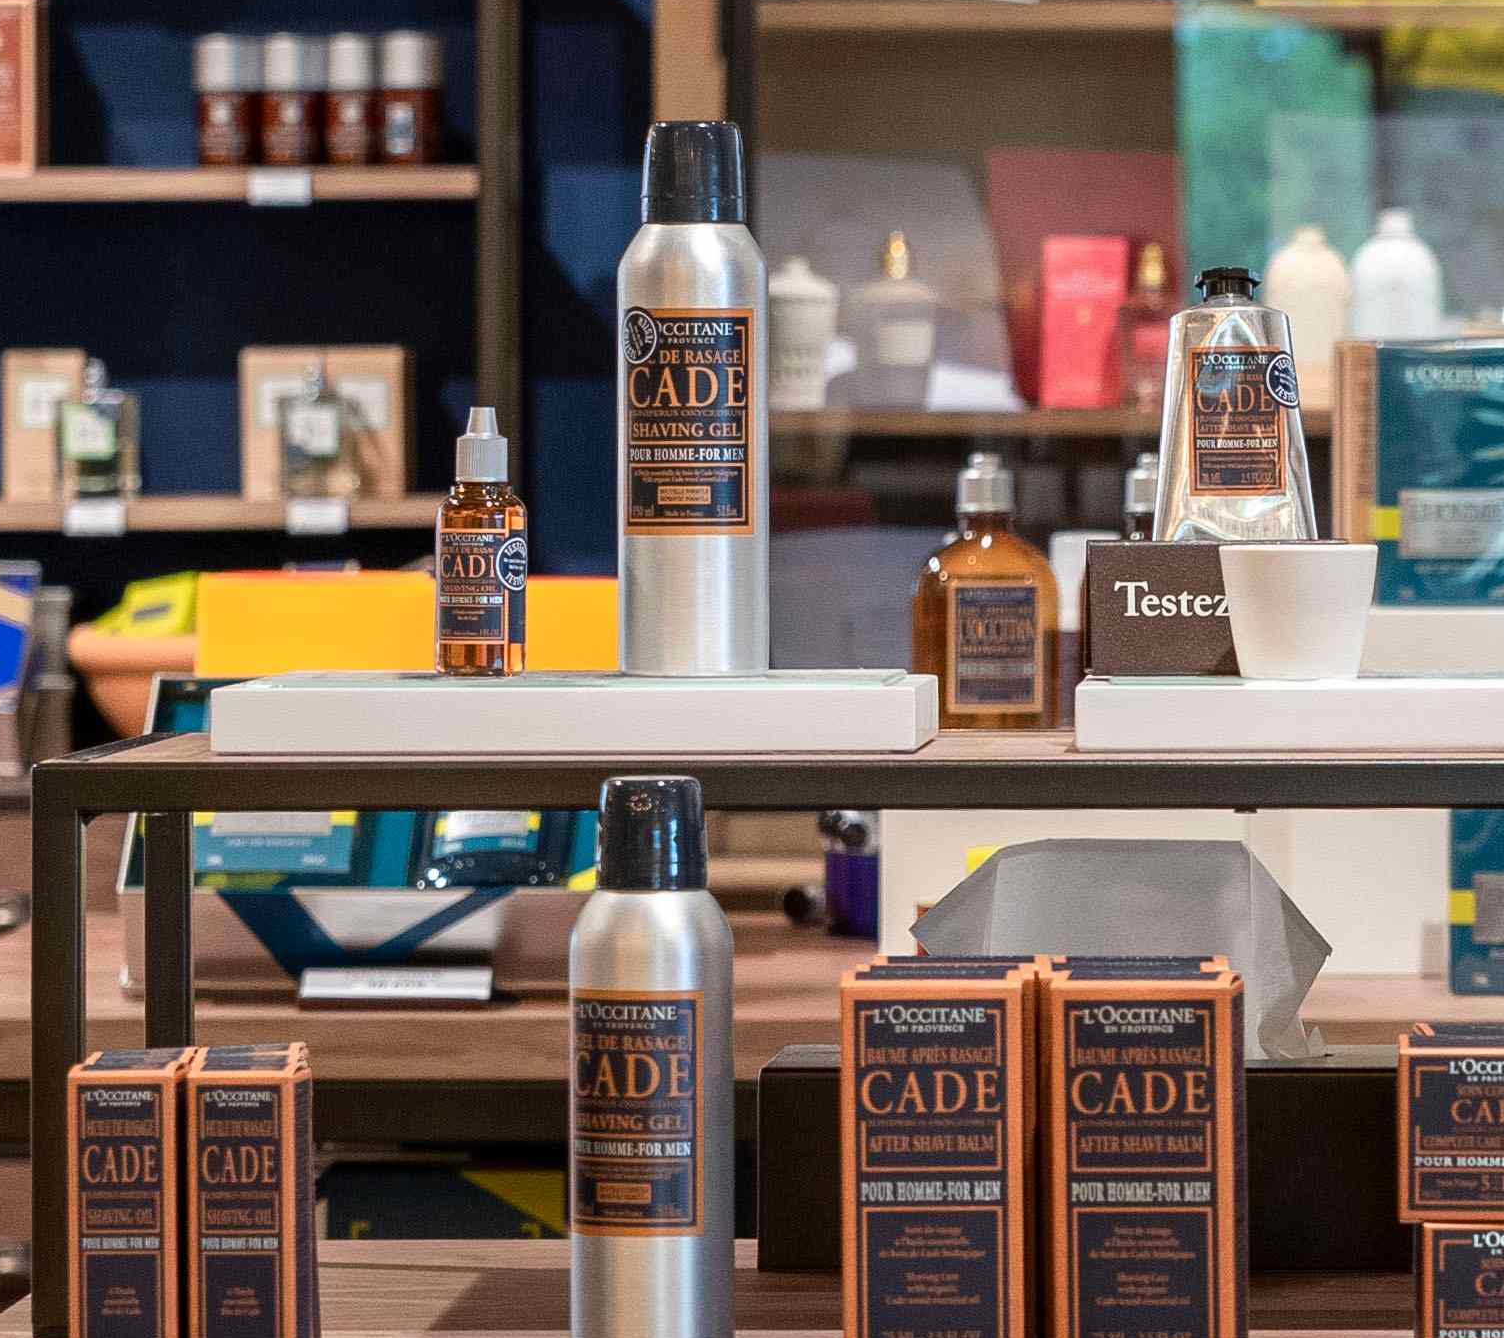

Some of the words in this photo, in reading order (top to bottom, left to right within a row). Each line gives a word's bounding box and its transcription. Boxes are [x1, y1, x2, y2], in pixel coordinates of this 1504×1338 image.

[657, 322, 734, 336] CCITANE
[659, 349, 681, 364] DE
[685, 348, 740, 364] RASAGE
[1201, 353, 1269, 365] L'OCCITANE
[628, 366, 746, 407] CADE
[1197, 384, 1274, 413] CADE
[632, 422, 704, 438] SHAVING
[708, 422, 741, 438] GEL
[630, 448, 653, 461] POUR
[654, 448, 721, 461] HOMME-FOR
[723, 448, 745, 461] MEN
[1114, 580, 1231, 617] Testez
[579, 1003, 678, 1021] L'OCCITANE
[873, 1005, 986, 1023] L'OCCITANE
[1083, 1005, 1196, 1024] L'OCCITANE
[895, 1025, 906, 1033] EN
[911, 1025, 965, 1033] PROVENCE
[1105, 1026, 1116, 1034] EN
[1121, 1026, 1174, 1034] PROVENCE
[599, 1035, 618, 1050] DE
[623, 1035, 689, 1050] RASAGE
[867, 1047, 908, 1063] BAUME
[950, 1047, 993, 1063] RASAGE
[1078, 1048, 1117, 1064] BAUME
[1160, 1048, 1203, 1064] RASAGE
[576, 1052, 693, 1098] CADE
[87, 1090, 153, 1102] L'OCCITANE
[205, 1090, 272, 1102] L'OCCITANE
[861, 1070, 1001, 1114] CADE
[1071, 1070, 1211, 1114] CADE
[649, 1113, 687, 1131] GEL
[594, 1141, 662, 1157] HOMME-FOR
[665, 1141, 692, 1157] MEN
[870, 1135, 909, 1152] AFTER
[912, 1135, 954, 1152] SHAVE
[958, 1135, 994, 1152] BALM
[1080, 1136, 1120, 1152] AFTER
[1123, 1135, 1164, 1152] SHAVE
[1167, 1135, 1203, 1152] BALM
[83, 1145, 159, 1183] CADE
[203, 1145, 277, 1183] CADE
[1415, 1156, 1452, 1167] POUR
[861, 1181, 894, 1201] POUR
[897, 1181, 970, 1201] HOMME-FOR
[974, 1180, 1001, 1201] MEN
[1071, 1182, 1104, 1202] POUR
[1107, 1182, 1180, 1202] HOMME-FOR
[1184, 1182, 1211, 1202] MEN
[1439, 1329, 1477, 1338] POUR
